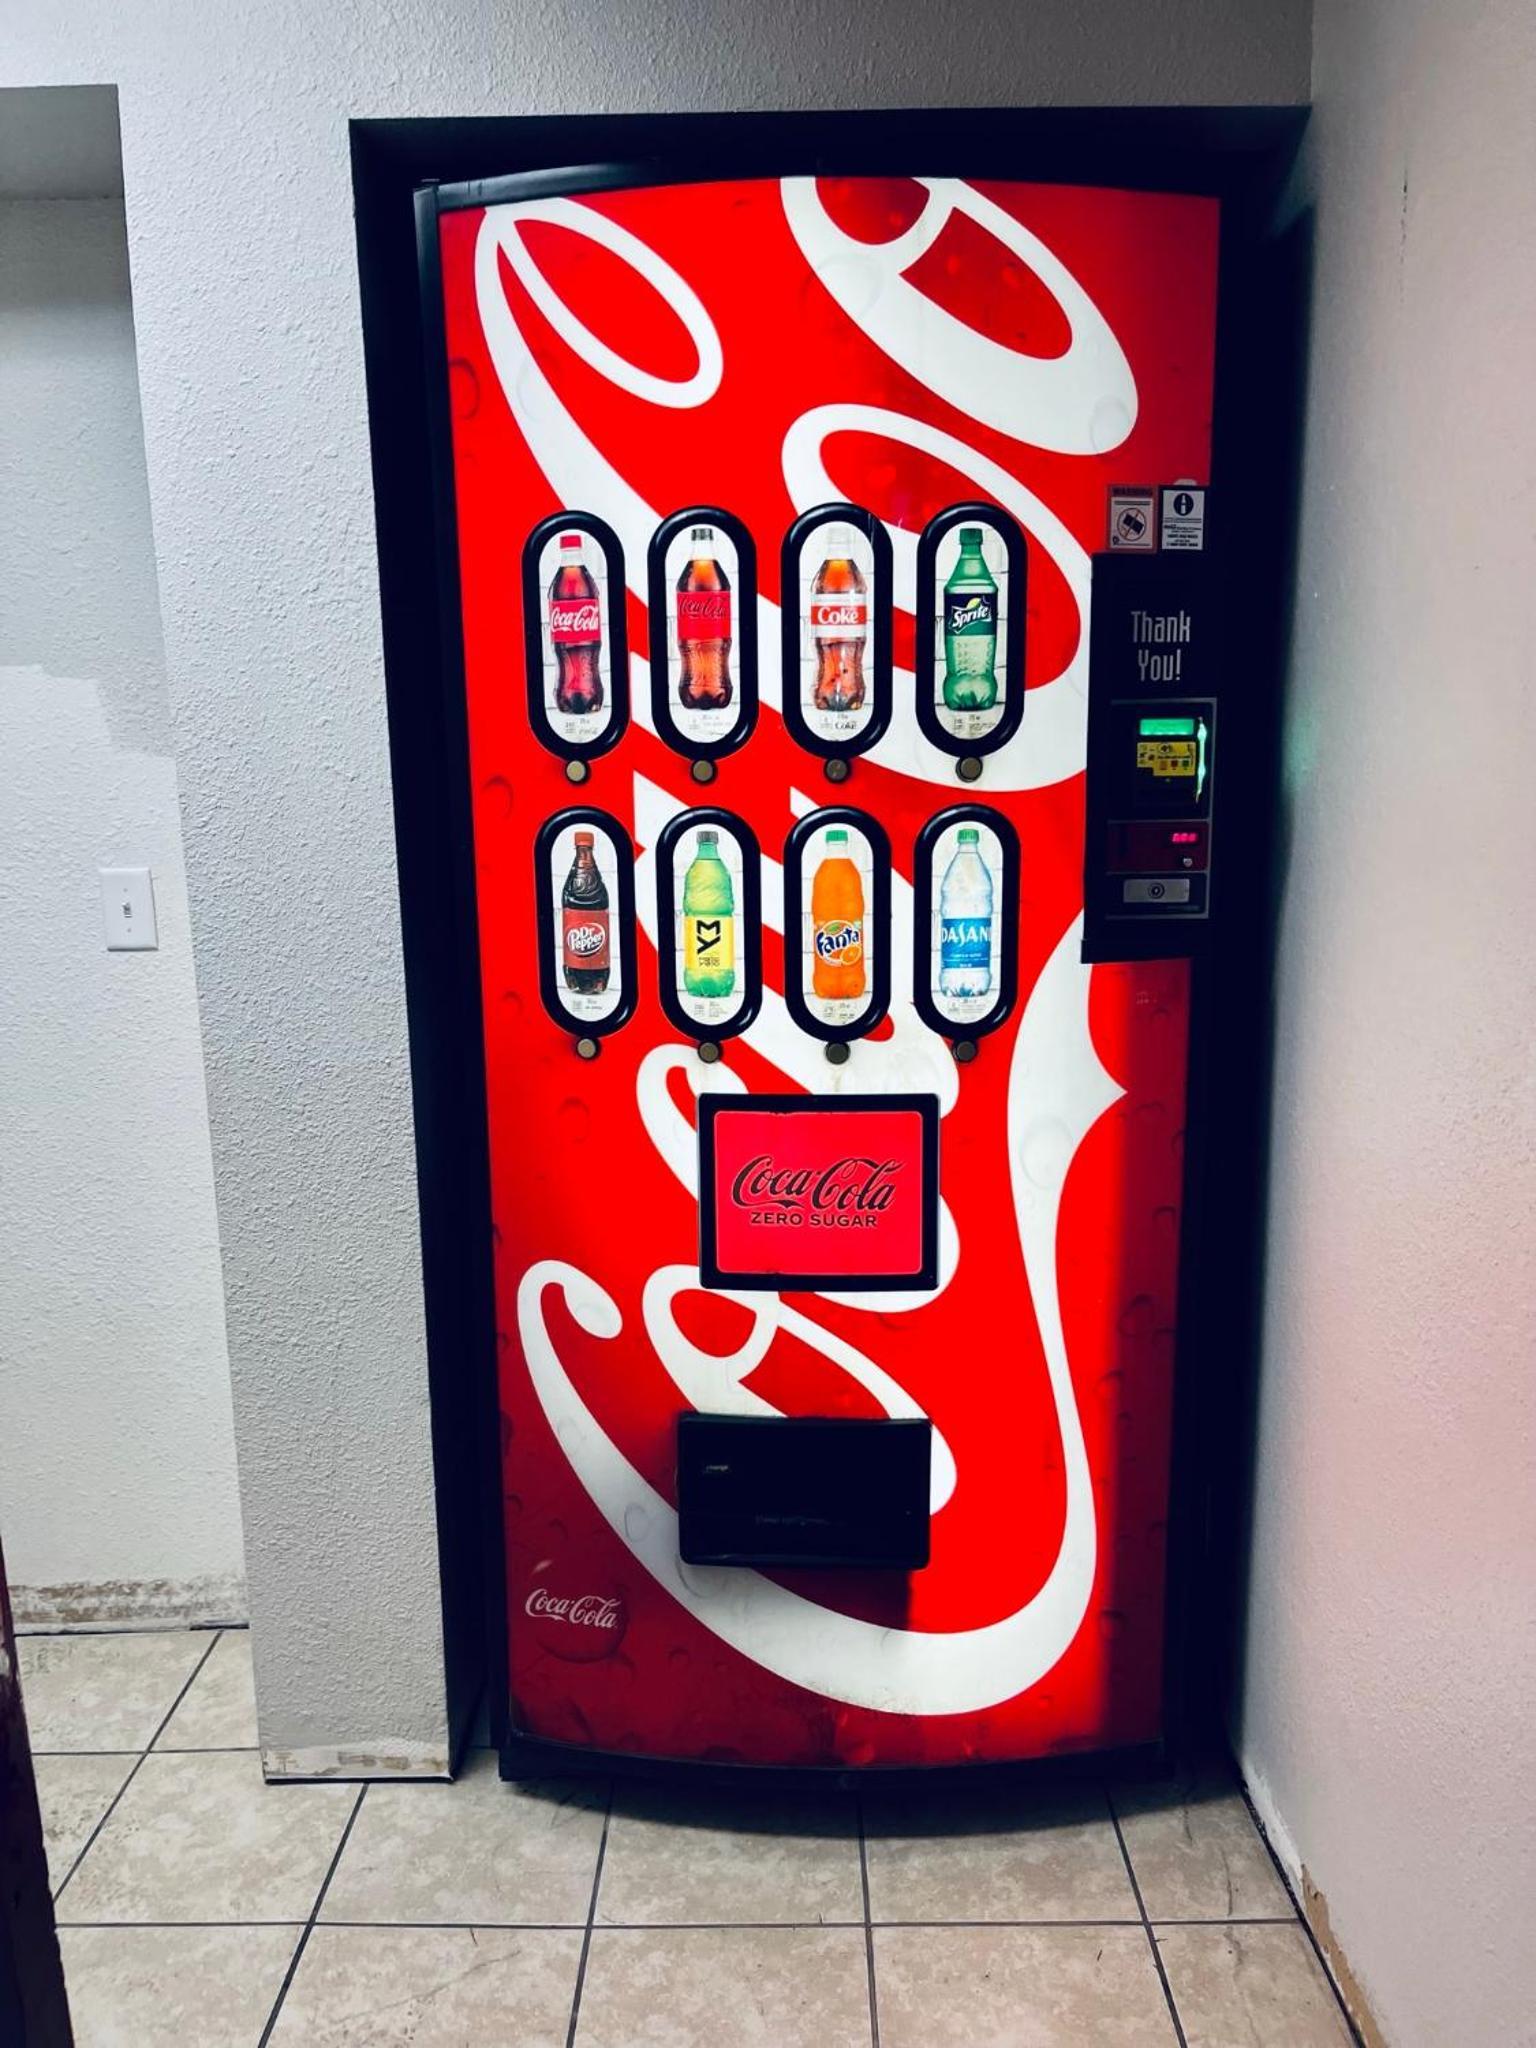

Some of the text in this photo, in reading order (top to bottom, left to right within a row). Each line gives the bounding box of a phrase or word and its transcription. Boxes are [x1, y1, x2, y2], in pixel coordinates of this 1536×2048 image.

[551, 605, 599, 632] Coca-Cola
[817, 606, 860, 625] Coke
[951, 604, 990, 629] Sprite
[1130, 610, 1191, 643] Thank
[1137, 648, 1182, 682] You!
[569, 928, 602, 951] Pepper
[579, 926, 596, 939] Dr
[941, 921, 991, 947] DASAN
[732, 1155, 906, 1212] Coca-Cola
[751, 1211, 878, 1228] ZERO SUGAR
[525, 1588, 621, 1628] Coca-Cola
